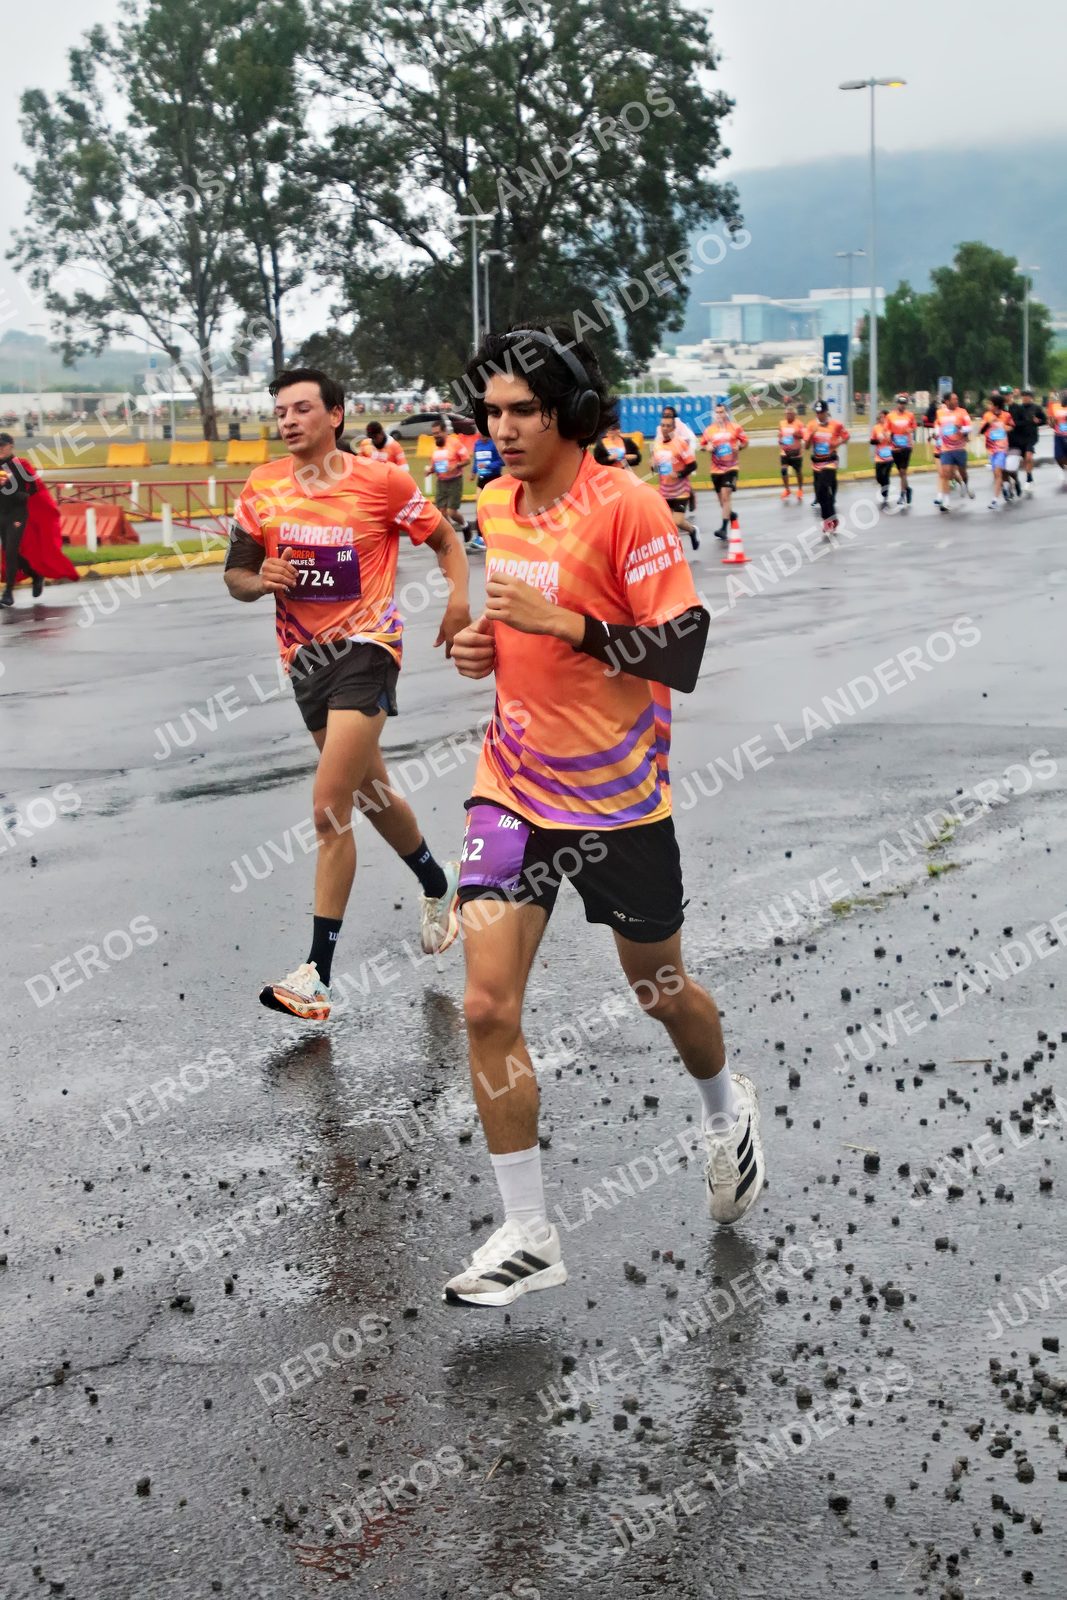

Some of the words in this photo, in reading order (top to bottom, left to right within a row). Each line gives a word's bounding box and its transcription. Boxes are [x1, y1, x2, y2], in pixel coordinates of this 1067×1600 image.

[827, 351, 842, 371] E
[280, 522, 353, 545] CARRERA
[291, 549, 315, 558] RRERA
[337, 550, 353, 562] 15K
[299, 570, 335, 587] 724
[497, 814, 522, 830] 15K
